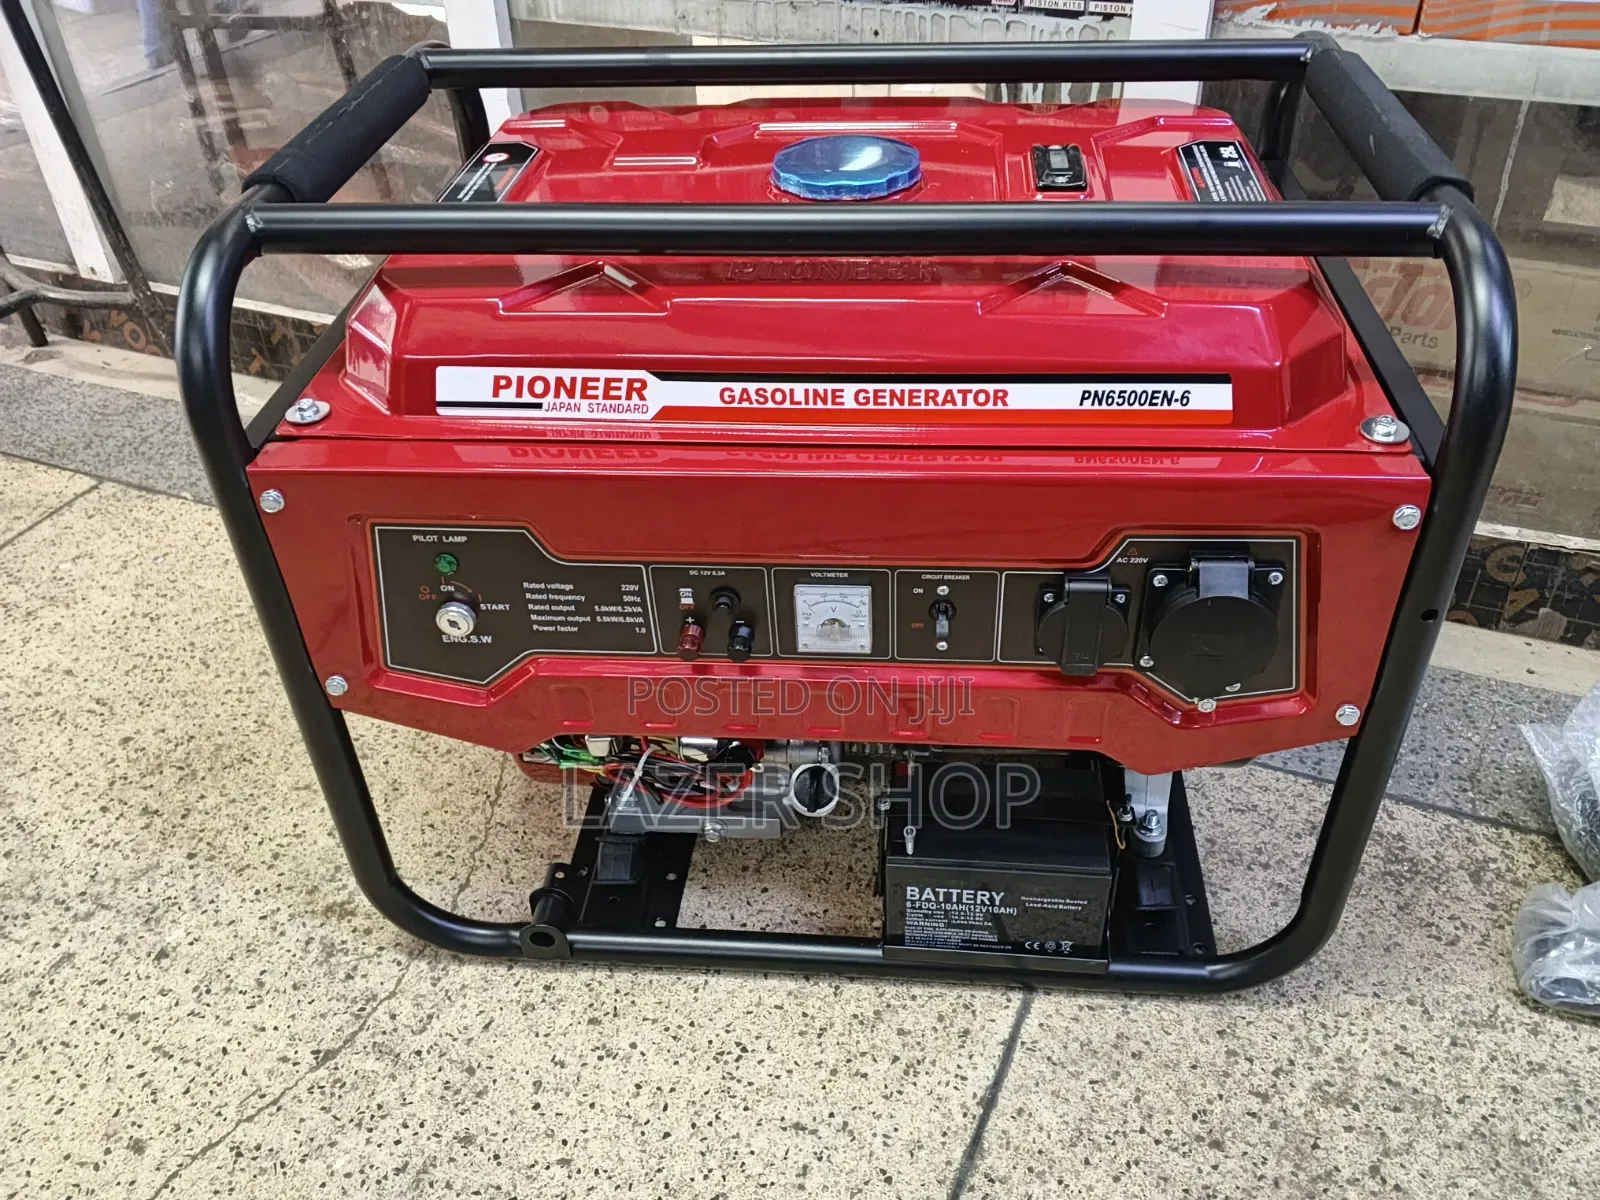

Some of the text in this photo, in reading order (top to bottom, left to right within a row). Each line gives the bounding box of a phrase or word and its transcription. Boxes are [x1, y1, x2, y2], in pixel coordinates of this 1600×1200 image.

[1063, 1, 1082, 9] KITS
[1094, 4, 1126, 12] PISTON
[1389, 325, 1438, 348] Parts
[491, 375, 648, 401] PIONEER
[719, 387, 1192, 407] GASOLINE GENERATOR PN6500EN-6
[544, 402, 649, 414] JAPAN STANDARD
[412, 534, 468, 543] PILOT LAMP
[546, 582, 574, 591] voltage
[548, 593, 585, 602] frequency
[480, 603, 511, 611] START
[528, 603, 550, 611] Rated
[551, 604, 576, 612] output
[441, 635, 492, 643] ENG.S.W
[906, 886, 1005, 906] BATTERY
[906, 901, 1017, 916] 6-FDQ-10AH(12V10AH)
